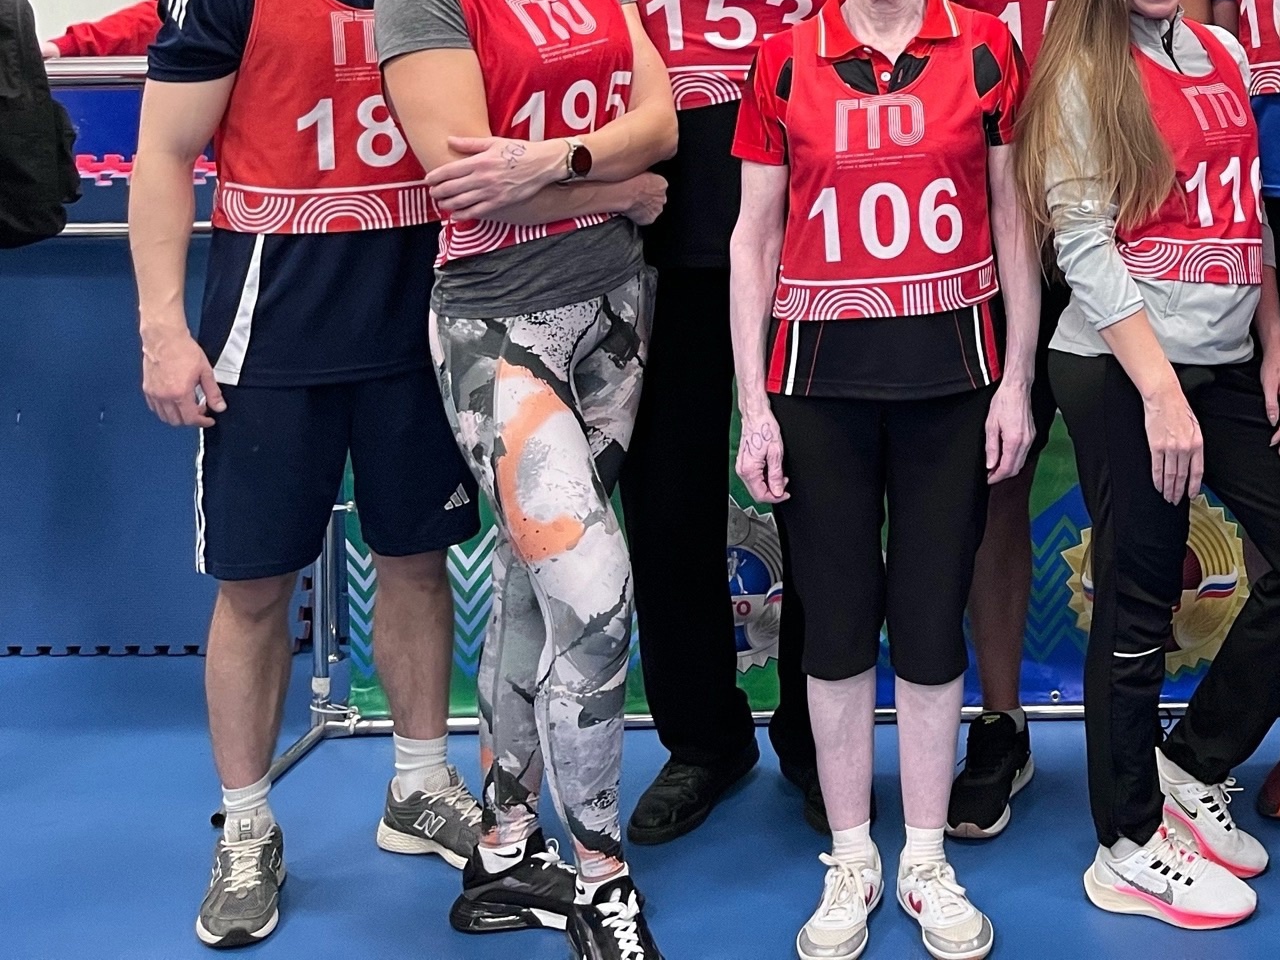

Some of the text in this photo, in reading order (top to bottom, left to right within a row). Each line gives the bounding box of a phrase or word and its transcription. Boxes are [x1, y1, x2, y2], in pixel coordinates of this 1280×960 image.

[330, 10, 378, 65] ГТ
[297, 94, 408, 171] 18
[836, 94, 925, 152] ГТО
[1181, 82, 1247, 131] ГТО
[808, 177, 963, 263] 106
